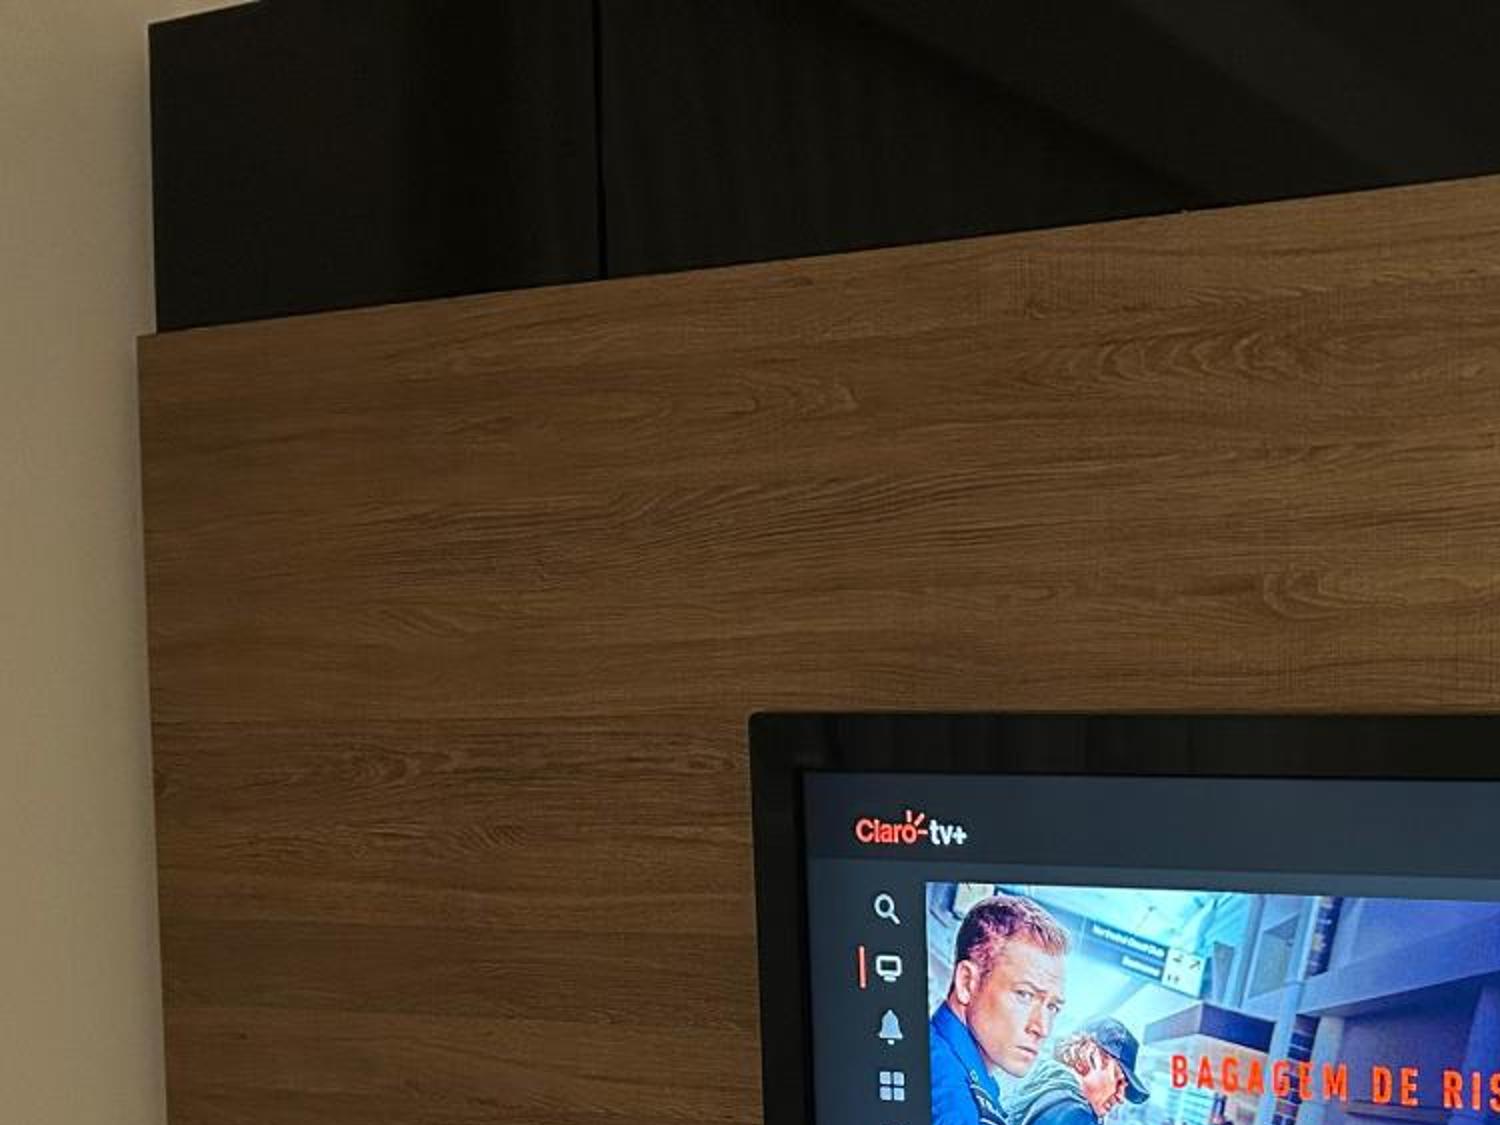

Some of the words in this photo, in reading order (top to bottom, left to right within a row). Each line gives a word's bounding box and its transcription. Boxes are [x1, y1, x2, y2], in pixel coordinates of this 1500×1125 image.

[856, 812, 920, 844] Claro
[929, 819, 967, 845] tv+
[1171, 1055, 1350, 1103] BAGAGEM
[1371, 1066, 1420, 1107] DE
